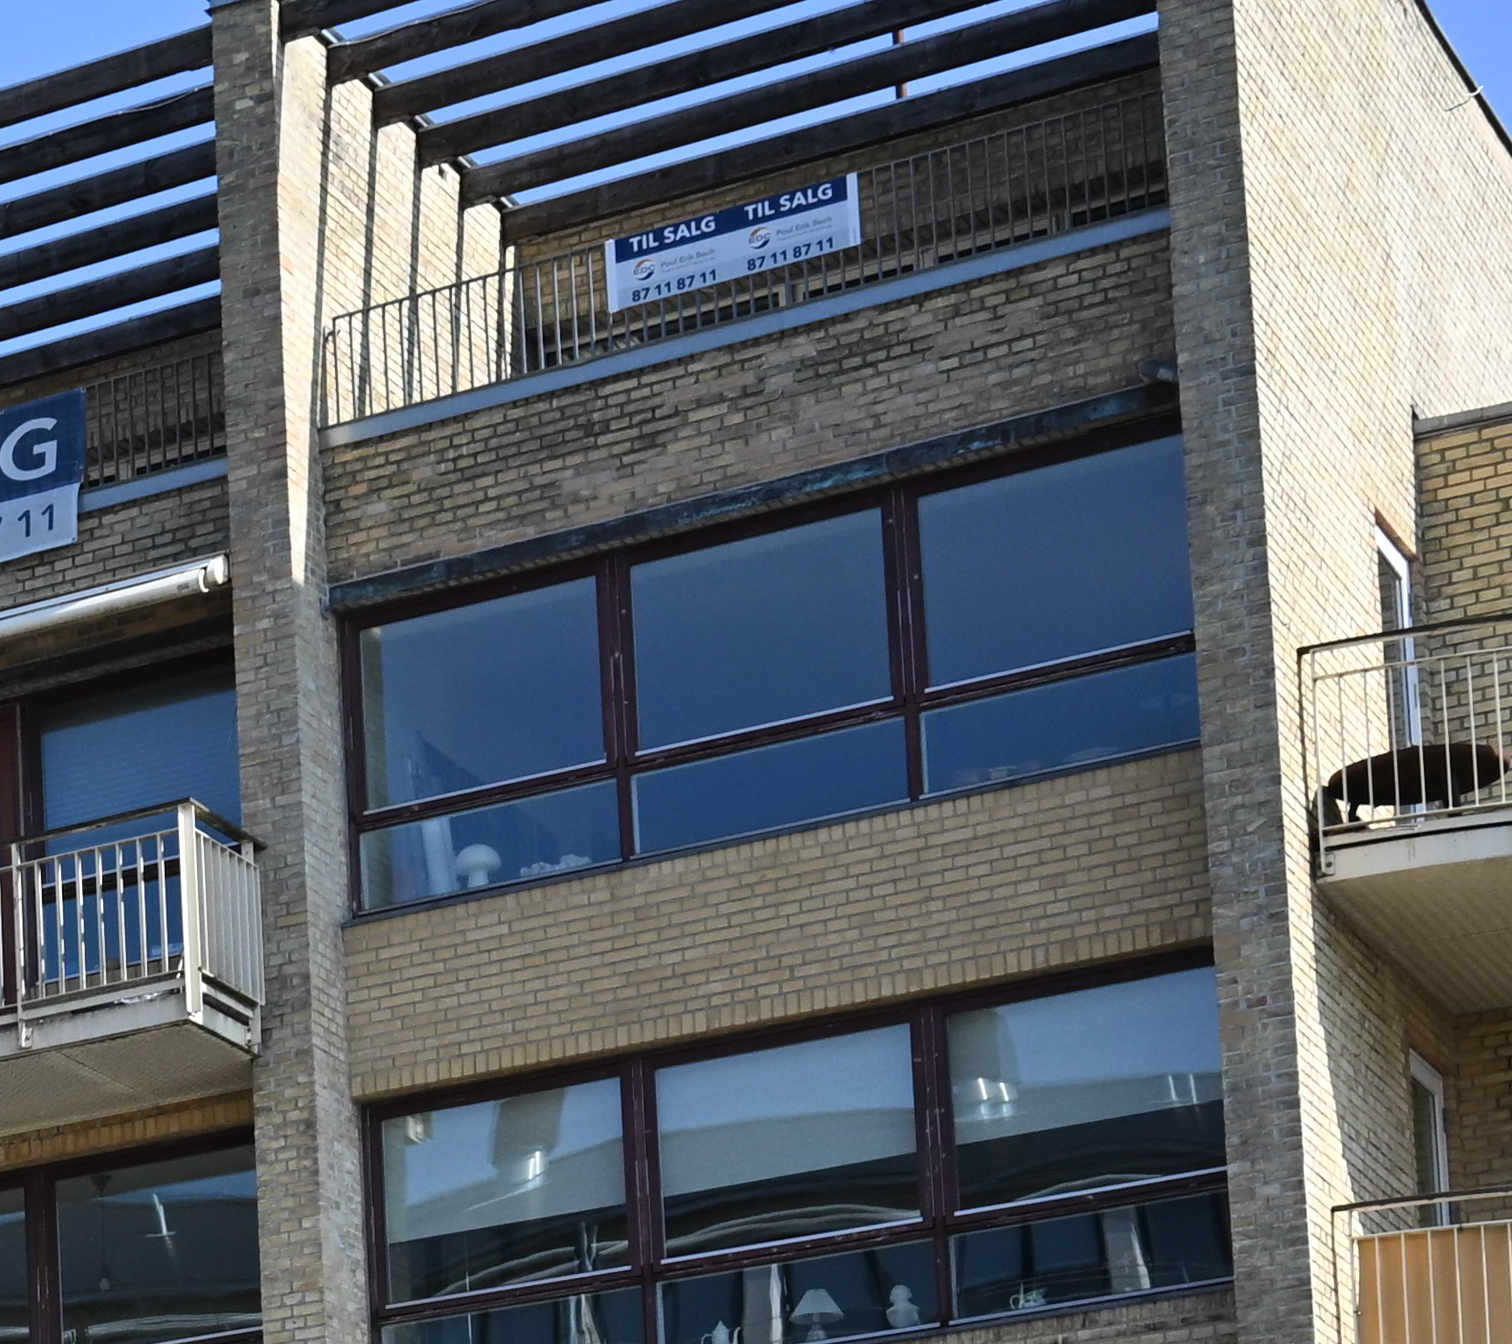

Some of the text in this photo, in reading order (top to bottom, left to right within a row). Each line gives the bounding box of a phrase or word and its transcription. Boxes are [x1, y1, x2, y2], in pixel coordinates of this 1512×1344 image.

[744, 183, 833, 220] TIL SALG
[629, 216, 716, 253] TIL SALG
[747, 237, 833, 271] 87 11 87 11
[632, 269, 716, 302] 87 11 87 11
[17, 504, 56, 539] 11
